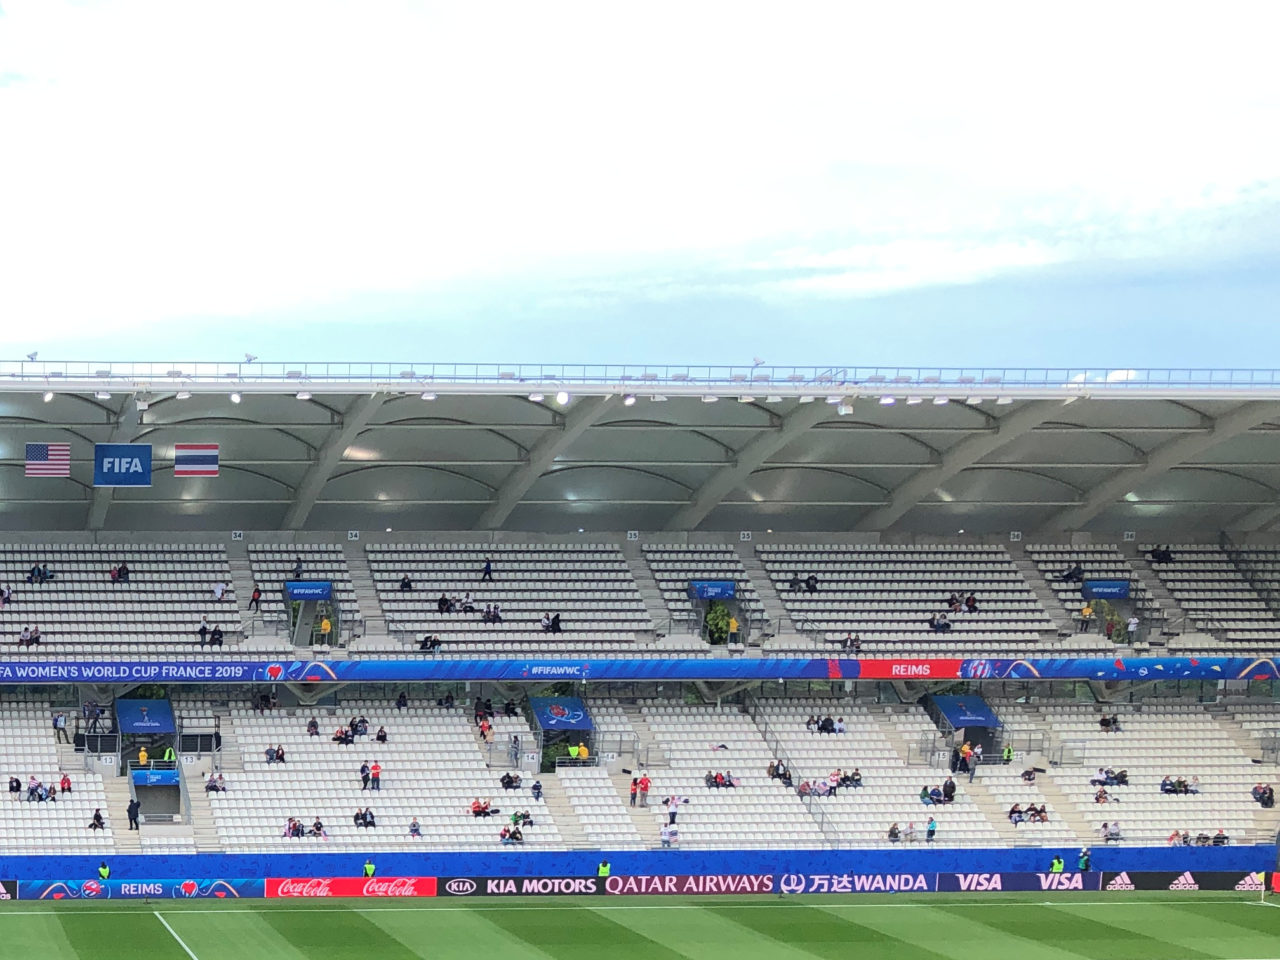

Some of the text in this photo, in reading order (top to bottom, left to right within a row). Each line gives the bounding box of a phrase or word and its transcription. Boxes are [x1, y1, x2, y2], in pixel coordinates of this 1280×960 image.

[102, 457, 144, 473] FIFA
[16, 665, 78, 678] WOMEN'S
[81, 666, 129, 678] WORLD
[132, 666, 159, 677] CUP
[161, 666, 212, 678] FRANCE
[531, 666, 580, 674] #FIFAWWC
[892, 665, 930, 675] REIMS
[121, 883, 163, 894] REIMS
[278, 879, 333, 896] Coca-Cola
[363, 878, 418, 896] Coca-Cola
[451, 882, 471, 891] KIA
[487, 879, 597, 893] KIA MOTORS
[605, 875, 773, 894] QATAR AIRWAYS
[955, 874, 1002, 890] VISA
[1036, 873, 1083, 889] VISA
